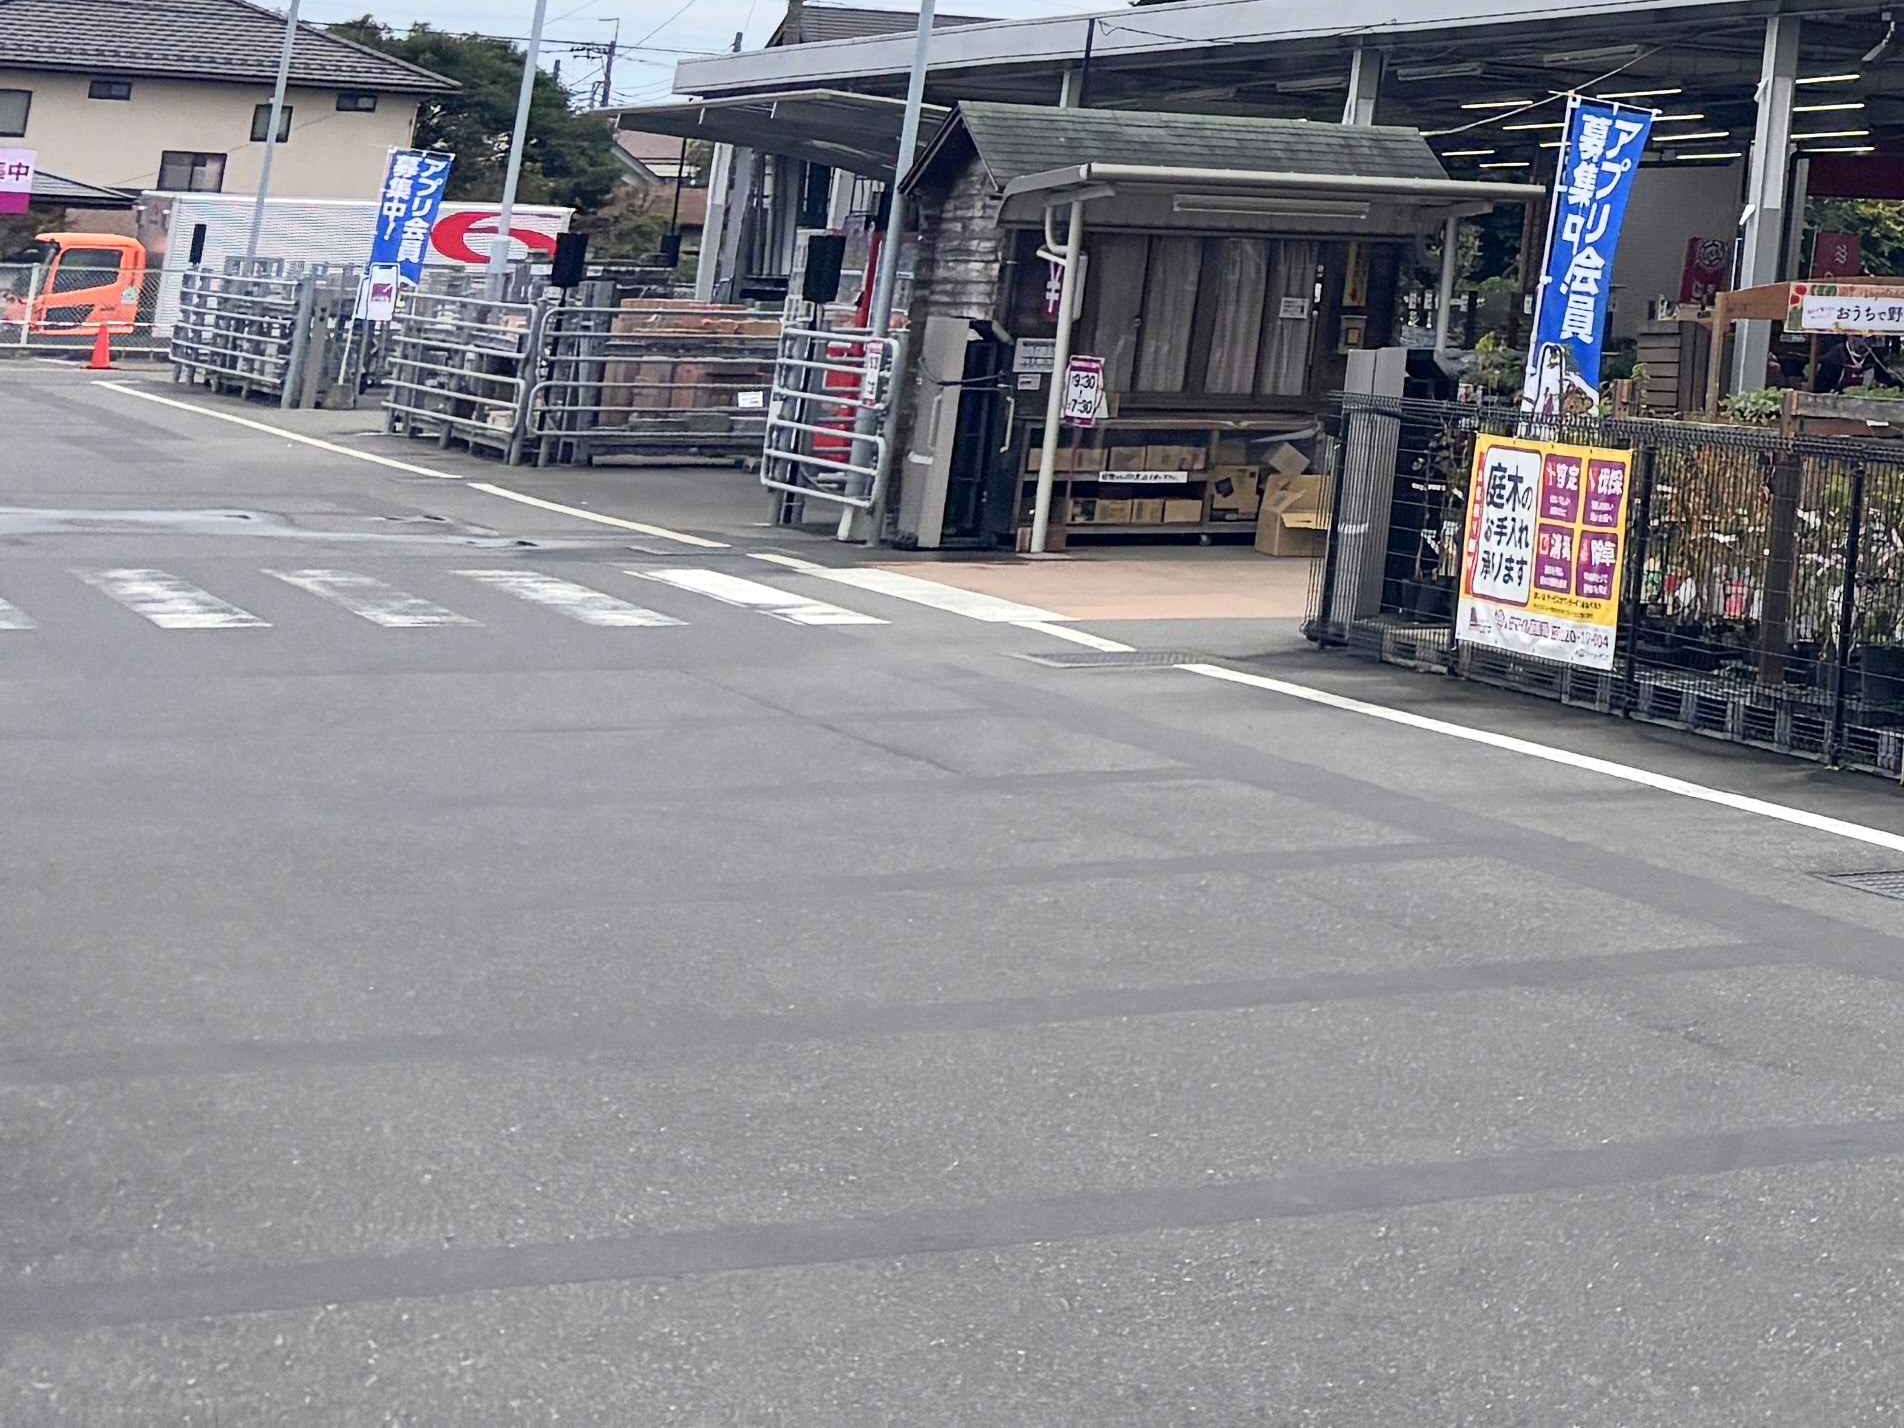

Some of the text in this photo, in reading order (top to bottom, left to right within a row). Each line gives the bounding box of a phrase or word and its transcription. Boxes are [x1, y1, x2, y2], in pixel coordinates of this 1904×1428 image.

[396, 158, 448, 263] アプリ会員
[1560, 118, 1645, 344] アプリ会員
[1486, 462, 1534, 511] 庭木の
[1483, 516, 1531, 550] お手入れ
[1479, 550, 1529, 587] 承ります
